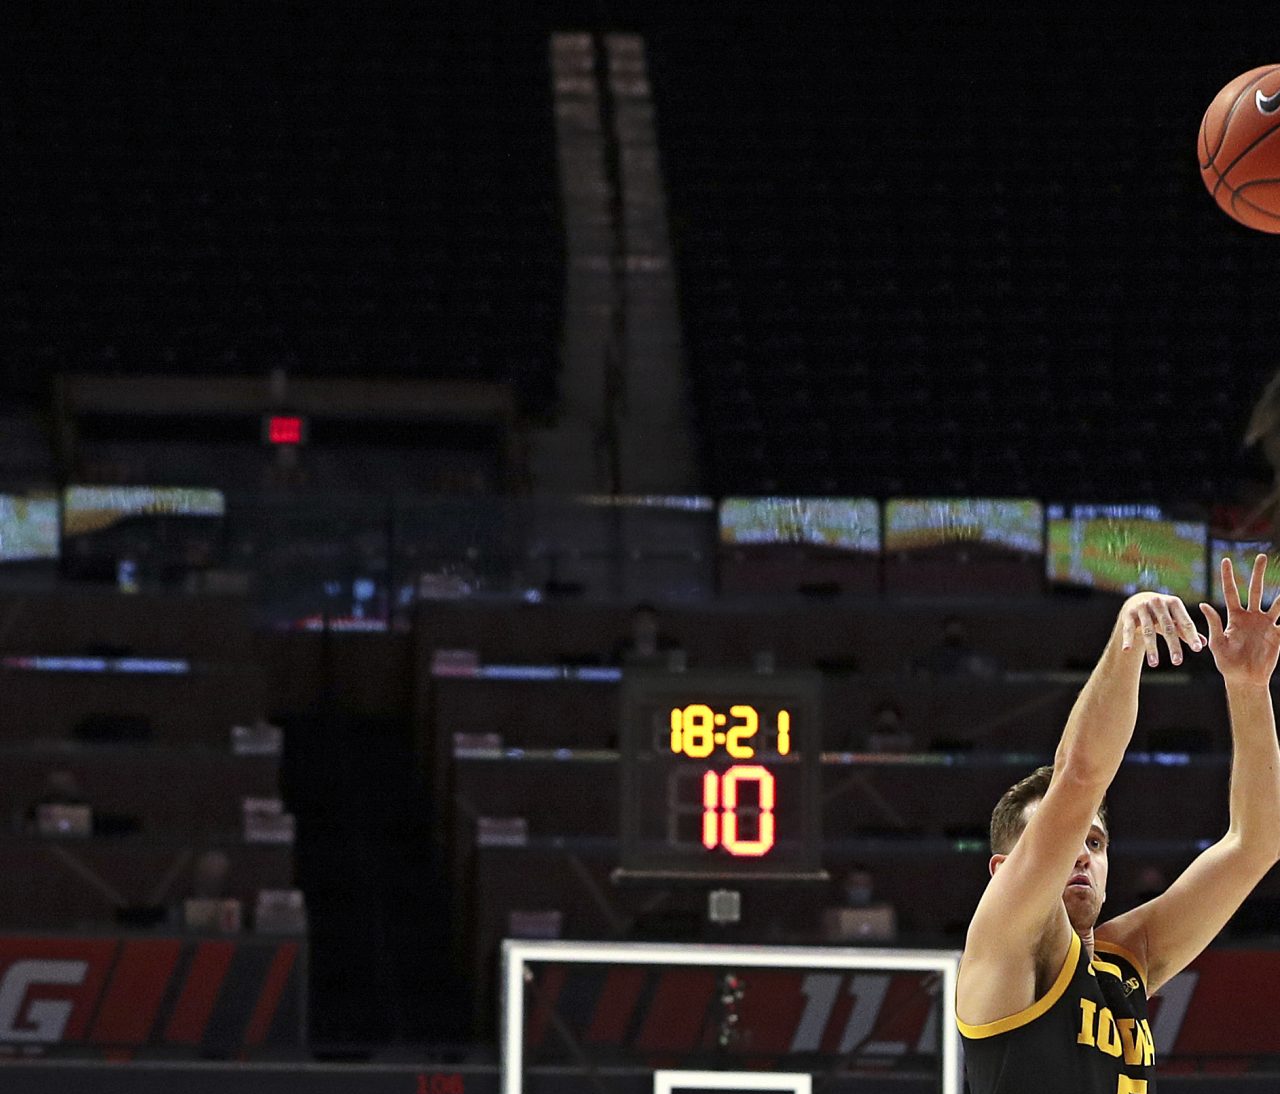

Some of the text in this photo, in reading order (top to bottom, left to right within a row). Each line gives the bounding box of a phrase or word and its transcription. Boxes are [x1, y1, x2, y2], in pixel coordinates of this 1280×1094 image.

[670, 704, 790, 758] 18:21
[702, 765, 775, 857] 10
[1077, 997, 1156, 1067] IOWA
